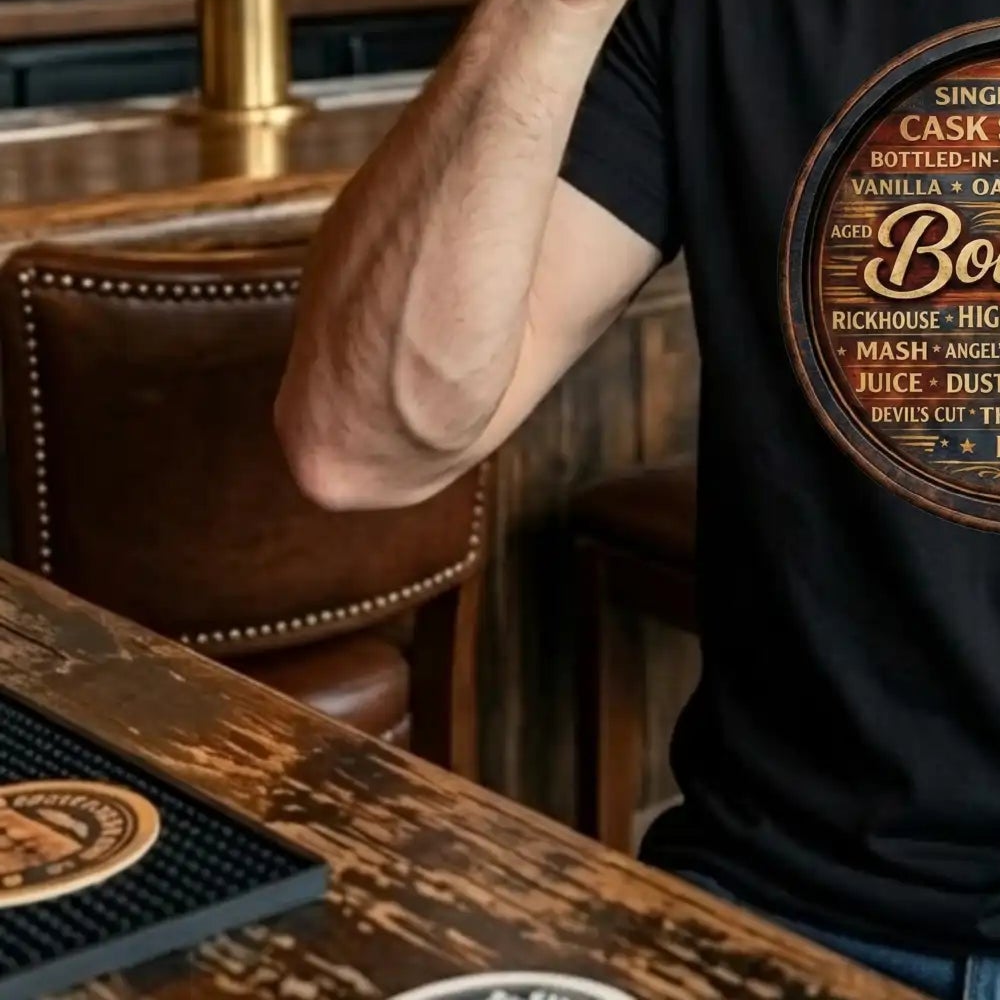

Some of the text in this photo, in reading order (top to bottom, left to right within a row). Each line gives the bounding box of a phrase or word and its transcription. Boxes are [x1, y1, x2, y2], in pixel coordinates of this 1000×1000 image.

[899, 115, 988, 141] CASK
[851, 179, 942, 196] VANILLA
[831, 224, 872, 239] AGED
[832, 311, 940, 330] RICKHOUSE
[856, 341, 927, 361] MASH
[856, 372, 923, 393] JUICE
[934, 406, 966, 423] CUT
